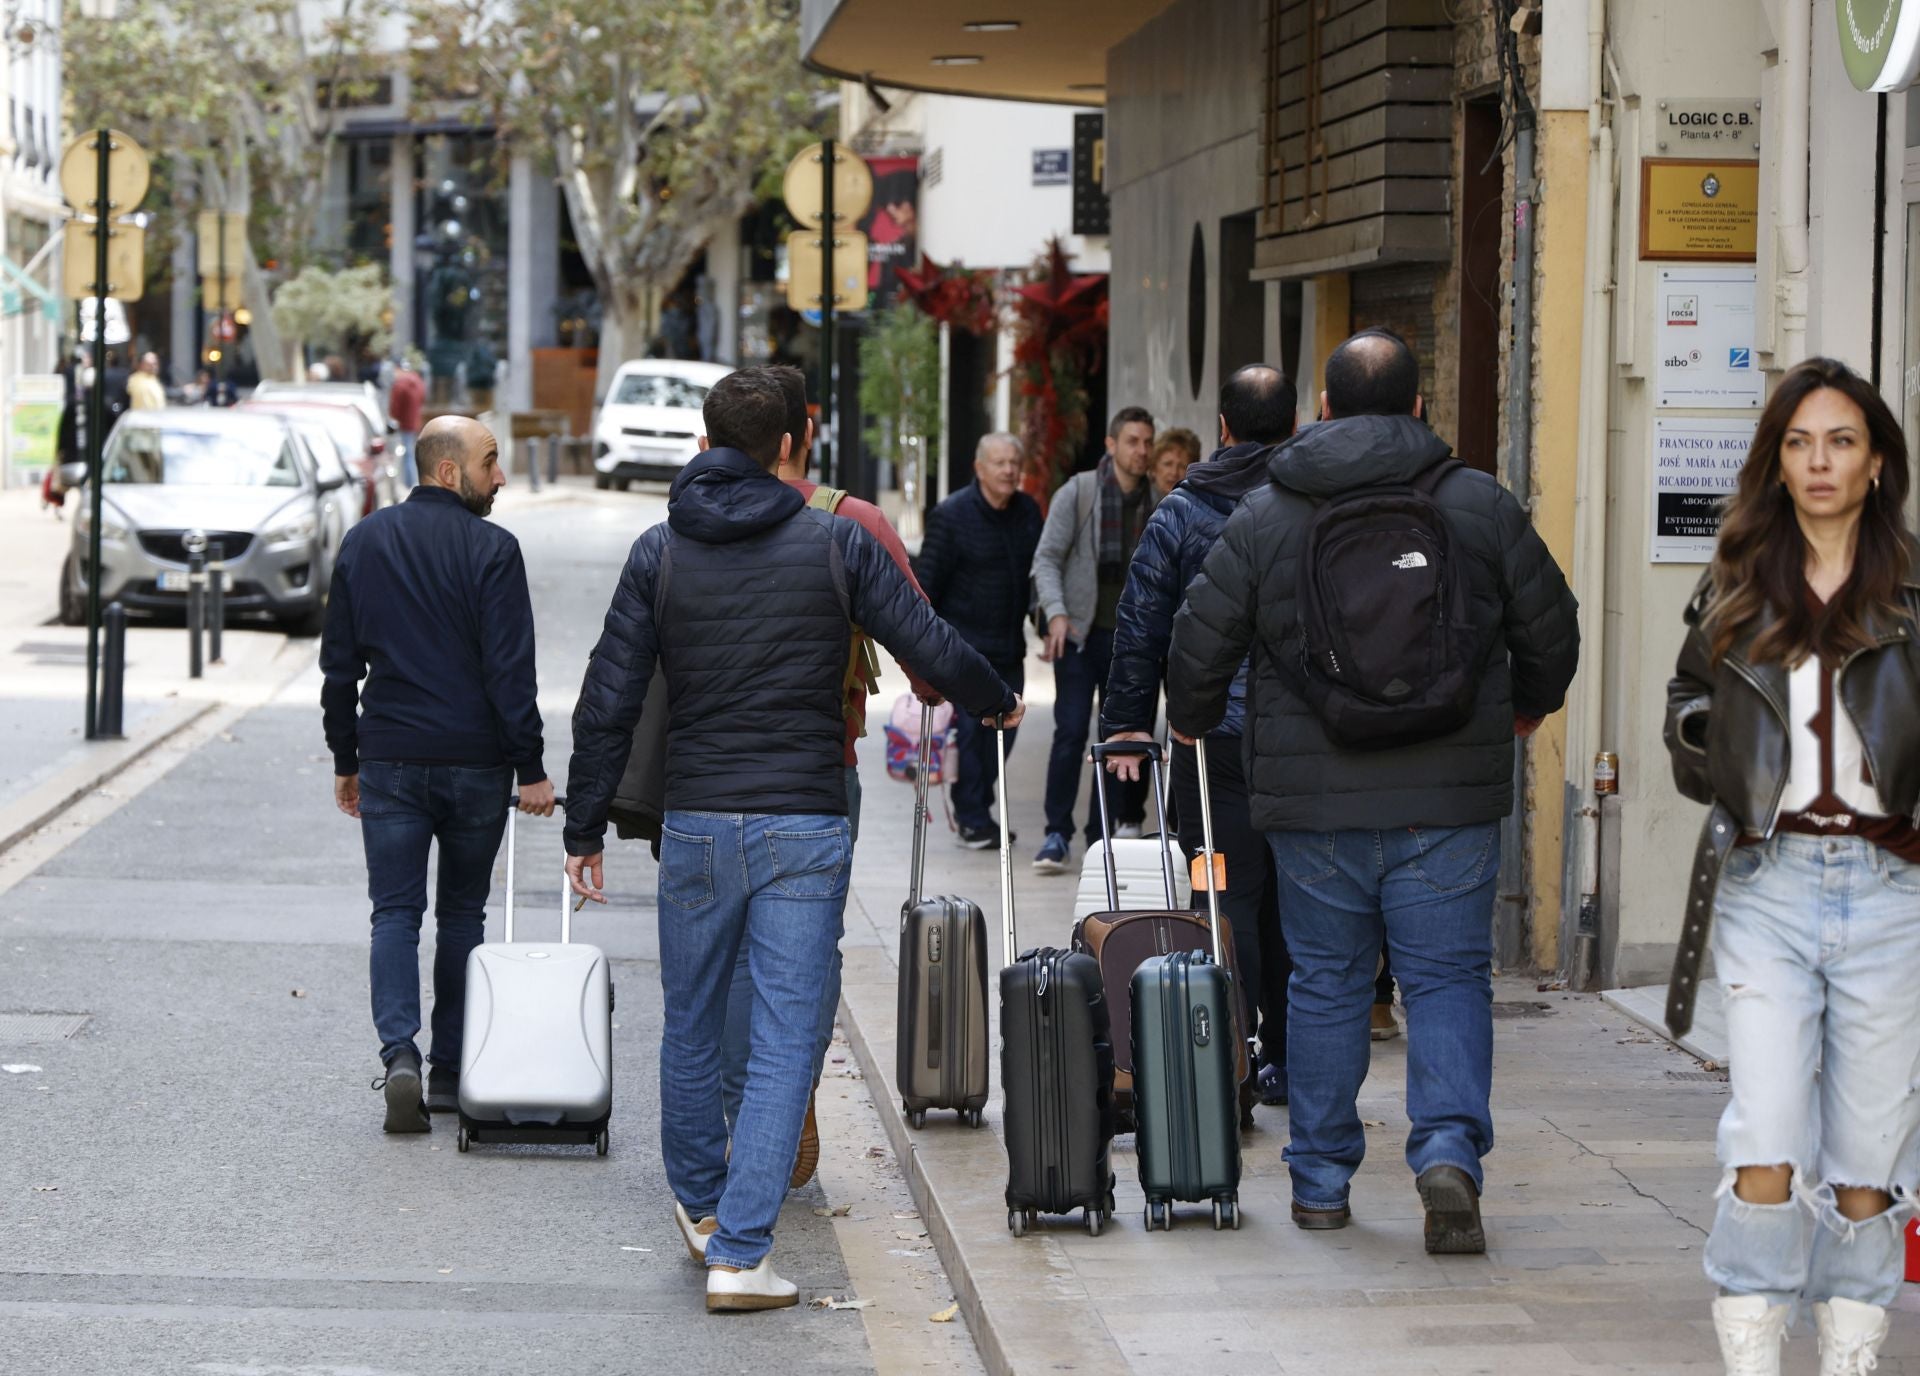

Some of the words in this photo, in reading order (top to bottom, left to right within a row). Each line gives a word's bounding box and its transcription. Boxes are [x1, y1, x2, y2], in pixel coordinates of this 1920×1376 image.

[1669, 112, 1718, 125] LOGIC
[1722, 112, 1753, 125] C.B.
[1680, 130, 1711, 139] Planta
[1671, 309, 1694, 318] rocsa
[1664, 355, 1688, 368] sibo
[1659, 438, 1713, 450] FRANCISCO
[1658, 454, 1681, 469] JOSÉ
[1685, 455, 1716, 469] MARÍA
[1658, 476, 1699, 487] RICARDO
[1701, 477, 1713, 488] DE
[1715, 477, 1739, 488] VICE
[1665, 516, 1702, 525] ESTUDIO
[1675, 526, 1681, 534] Y
[1401, 552, 1415, 560] THE
[1392, 557, 1416, 566] NORTH
